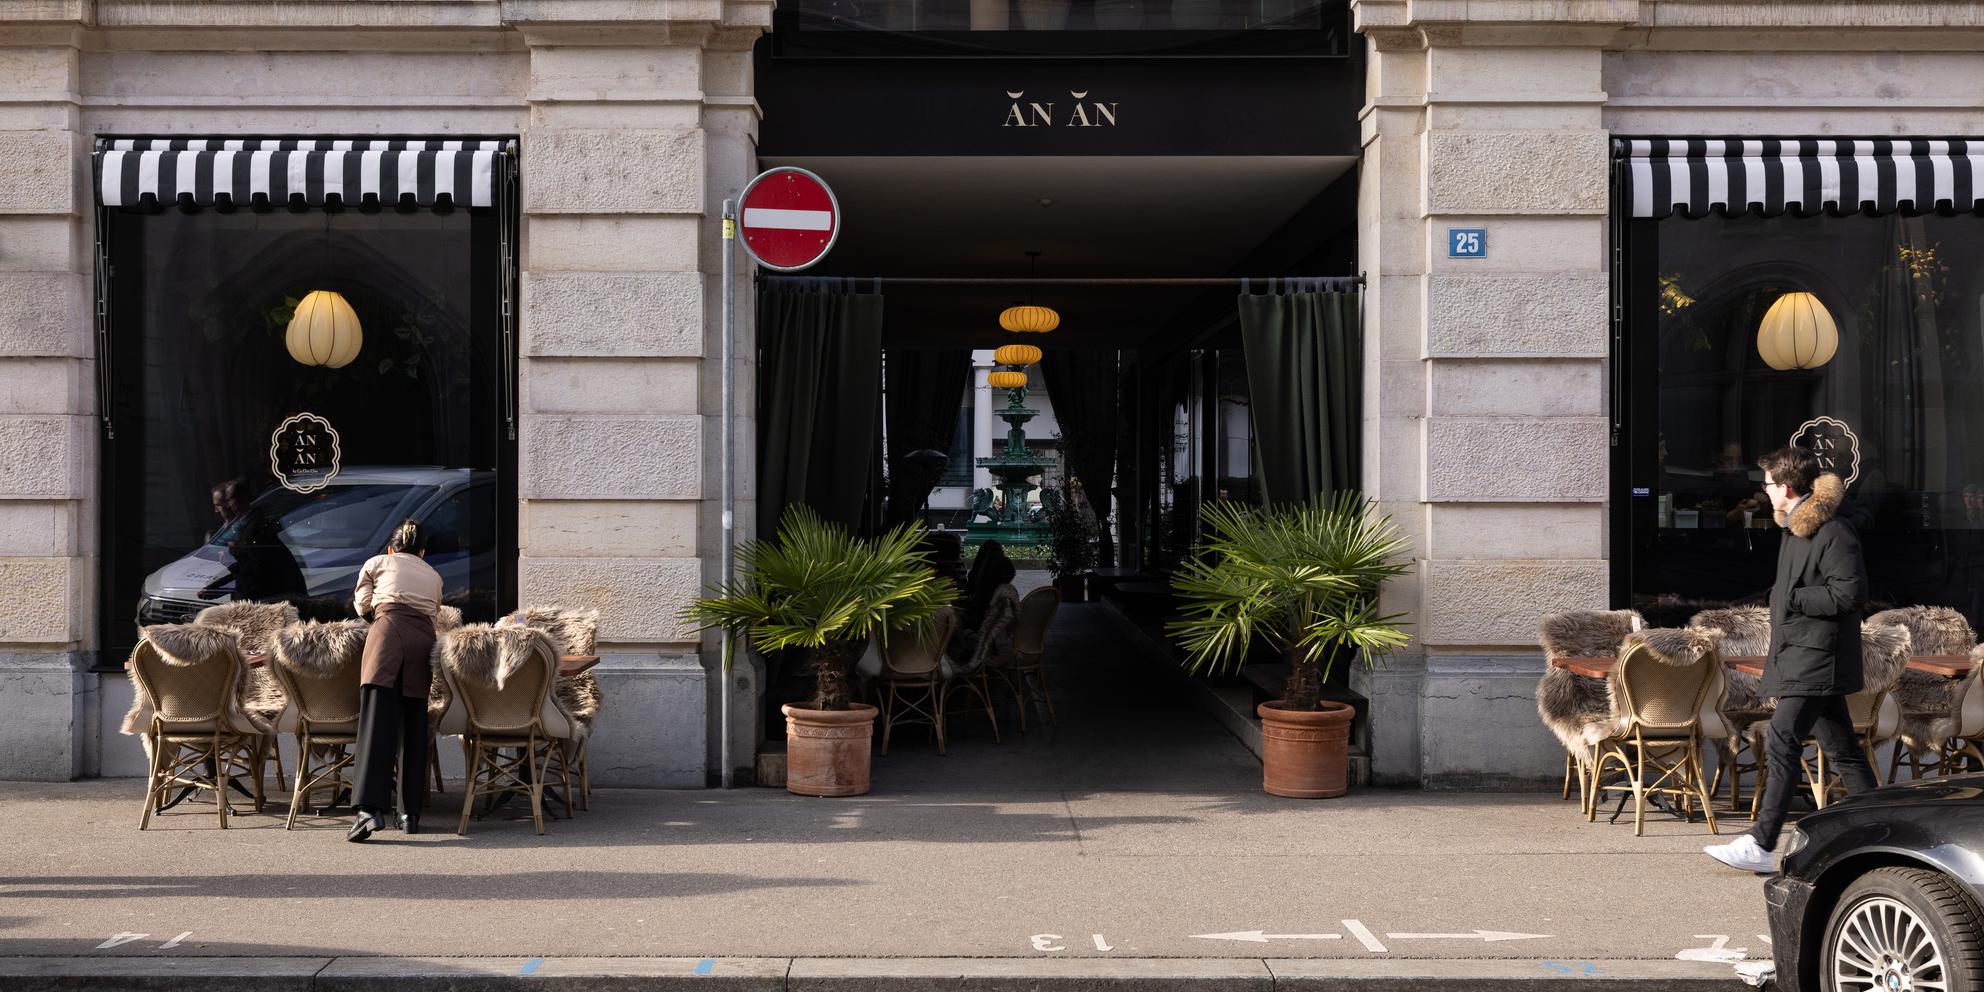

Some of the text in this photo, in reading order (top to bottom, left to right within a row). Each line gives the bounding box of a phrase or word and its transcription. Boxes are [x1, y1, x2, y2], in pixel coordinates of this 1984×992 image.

[1002, 90, 1120, 127] ĂN ĂN
[1456, 232, 1479, 254] 25
